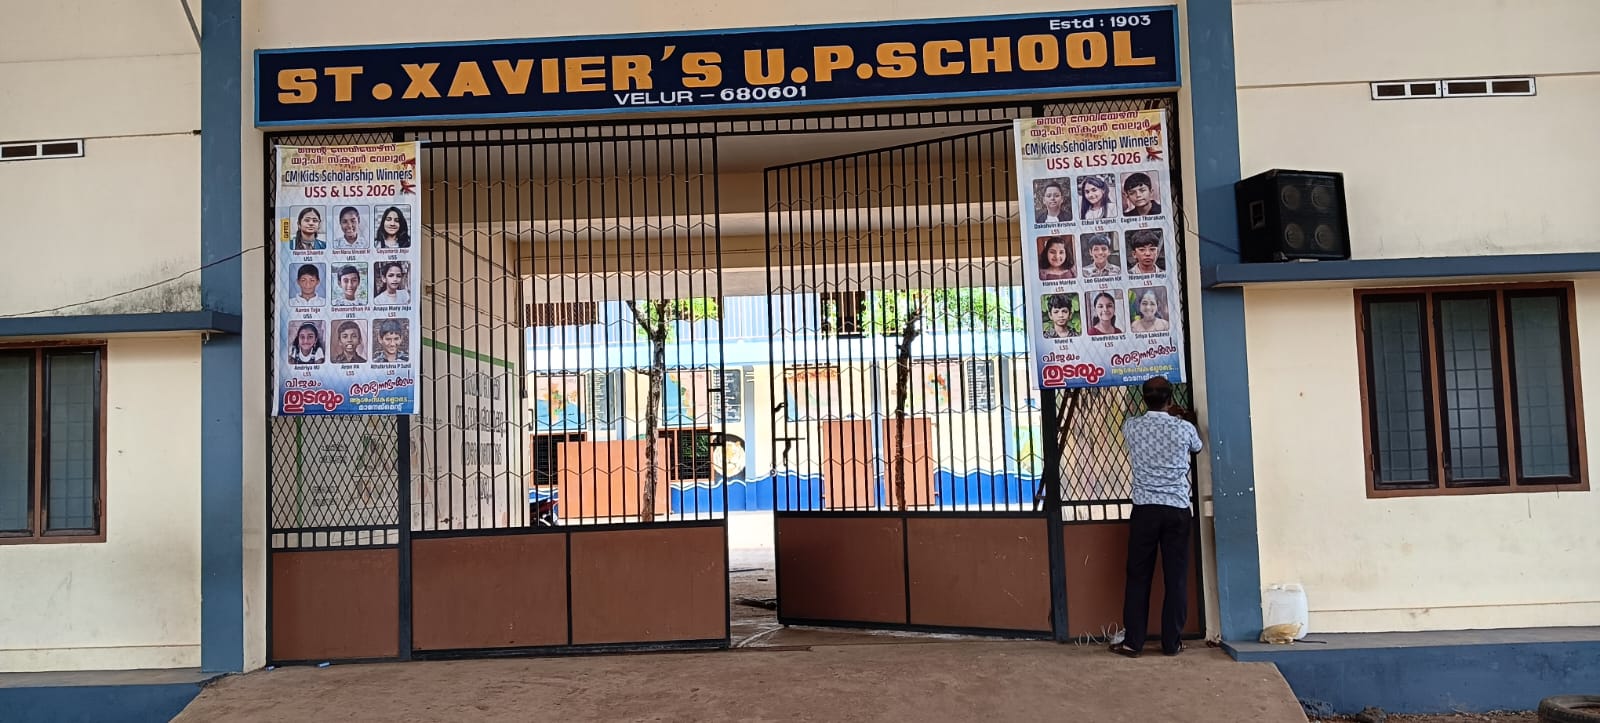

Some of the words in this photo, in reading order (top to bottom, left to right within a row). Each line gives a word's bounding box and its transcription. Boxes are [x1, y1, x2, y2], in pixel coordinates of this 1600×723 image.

[1048, 17, 1095, 31] Estd
[1110, 14, 1151, 29] 1903
[613, 89, 694, 106] VELUR
[719, 85, 807, 101] 680601
[1025, 143, 1039, 156] CM
[1041, 141, 1061, 154] Kids
[1063, 137, 1117, 153] Scholarship
[1119, 135, 1158, 149] Winners
[1046, 157, 1070, 170] USS
[1073, 156, 1083, 168] &
[1086, 154, 1107, 167] LSS
[1111, 152, 1141, 165] 2026
[285, 170, 298, 182] CM
[300, 170, 320, 182] Kids
[321, 169, 374, 183] Scholarship
[376, 168, 413, 180] Winners
[304, 186, 327, 198] USS
[330, 186, 340, 197] &
[343, 185, 363, 197] LSS
[366, 184, 395, 196] 2026
[1043, 363, 1105, 387] തുടരും
[284, 390, 343, 413] തുടരും
